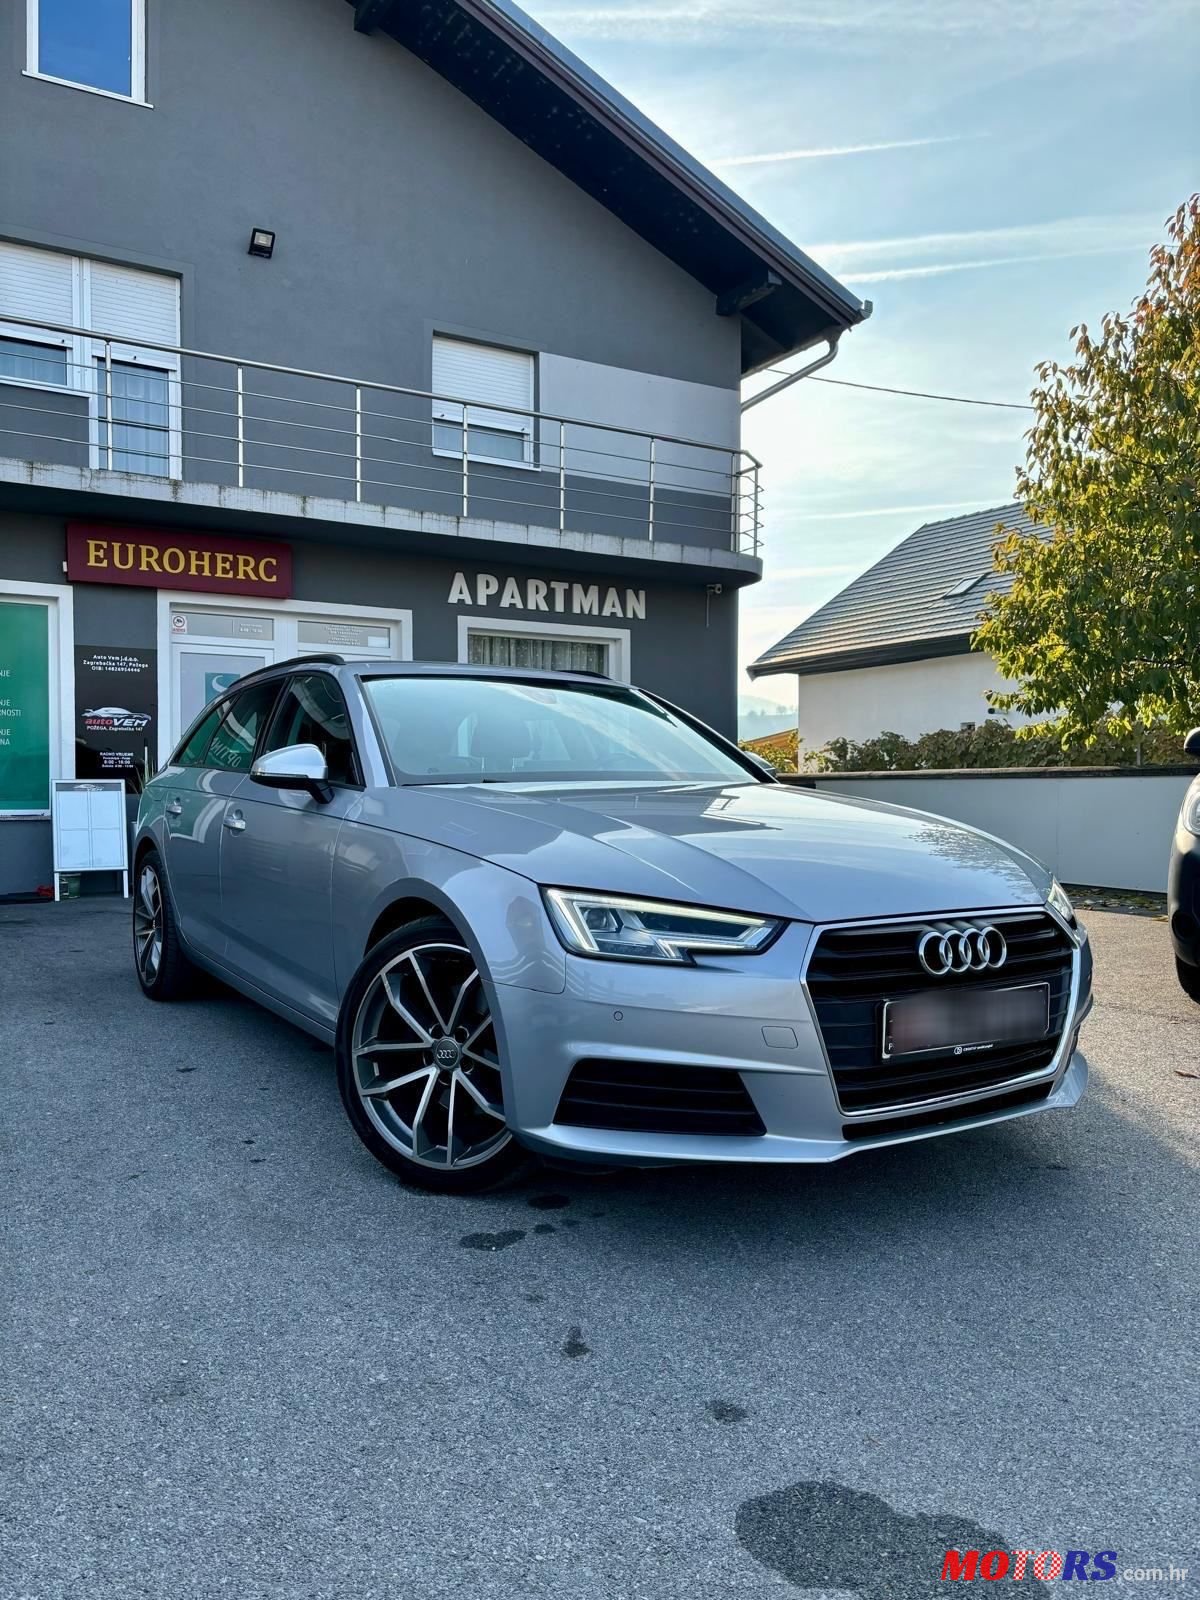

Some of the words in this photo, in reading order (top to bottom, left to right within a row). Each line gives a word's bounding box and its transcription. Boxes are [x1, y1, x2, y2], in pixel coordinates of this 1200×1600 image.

[86, 539, 277, 582] EUROHERC
[447, 572, 646, 620] APARTMAN
[0, 708, 21, 716] NOSTI
[85, 718, 148, 727] autoVEM
